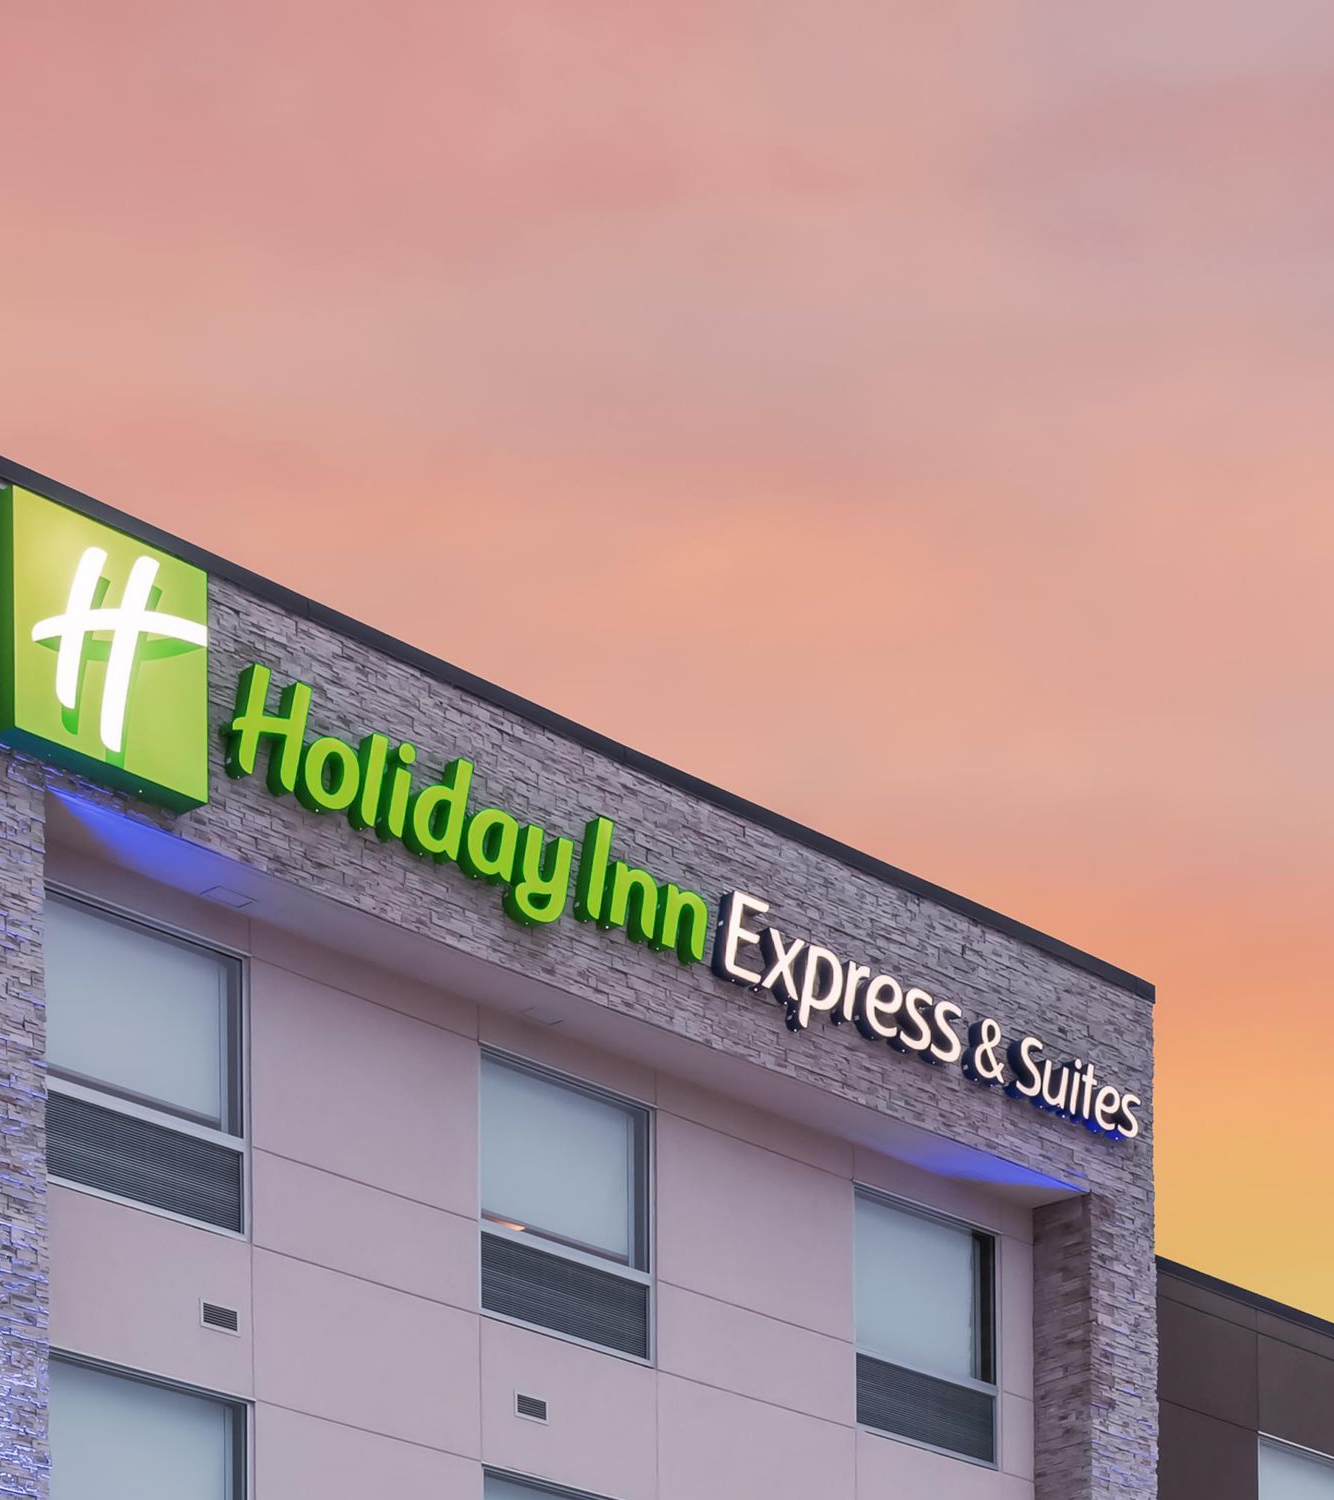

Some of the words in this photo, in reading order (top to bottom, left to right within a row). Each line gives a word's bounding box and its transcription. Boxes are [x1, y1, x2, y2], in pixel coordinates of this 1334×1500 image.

[228, 662, 574, 927] Holiday
[579, 816, 709, 964] Inn
[717, 890, 963, 1064] Express
[968, 1017, 1006, 1088] &
[1009, 1036, 1141, 1140] Suites
